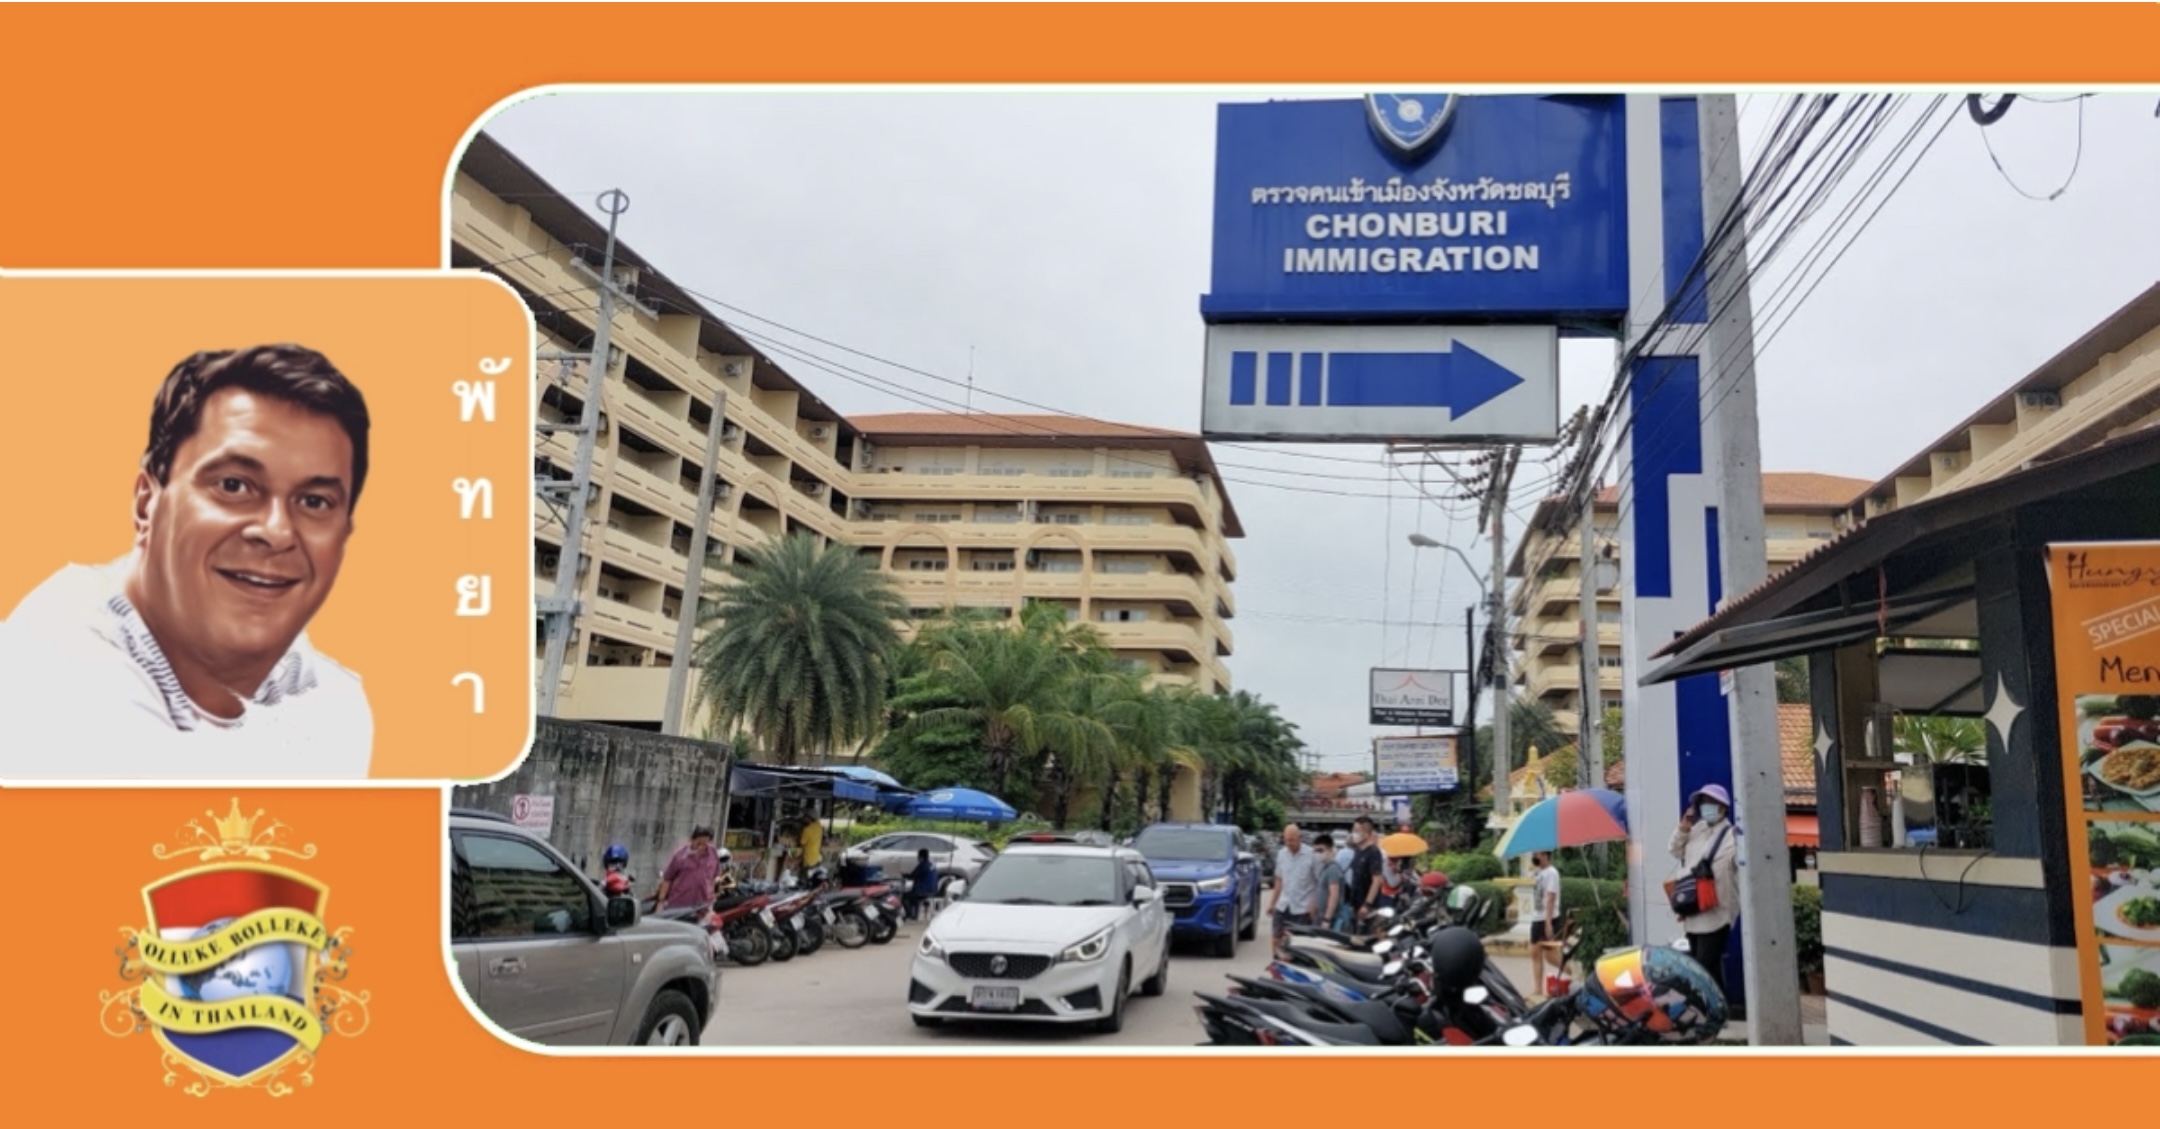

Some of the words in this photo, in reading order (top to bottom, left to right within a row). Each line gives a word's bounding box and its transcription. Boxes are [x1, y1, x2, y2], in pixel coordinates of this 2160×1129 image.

[1251, 172, 1570, 209] ตรวจคนเข้าเมืองจังหวัดชลบุรี
[1305, 210, 1507, 239] CHONBURI
[1283, 245, 1539, 273] IMMIGRATION
[2066, 551, 2160, 587] Hungr
